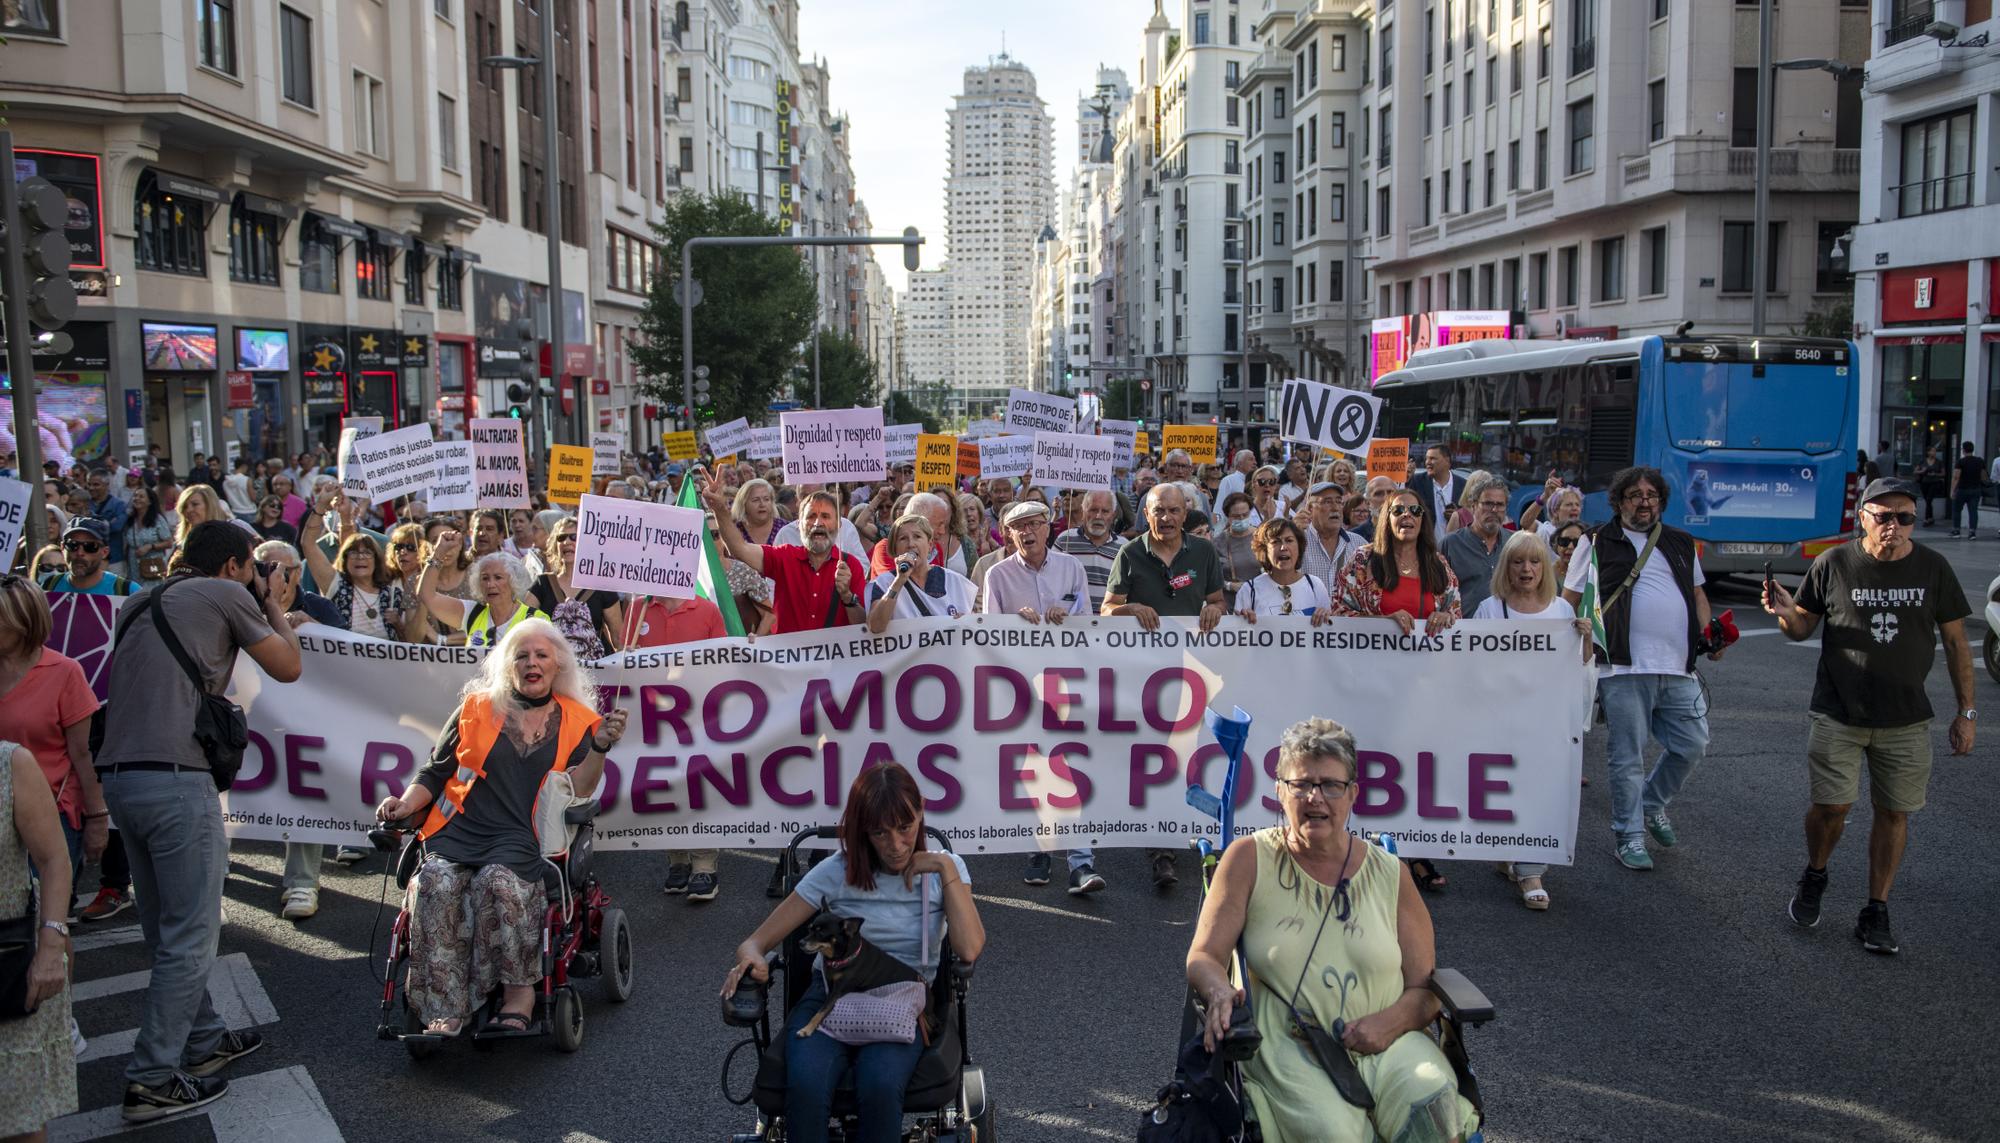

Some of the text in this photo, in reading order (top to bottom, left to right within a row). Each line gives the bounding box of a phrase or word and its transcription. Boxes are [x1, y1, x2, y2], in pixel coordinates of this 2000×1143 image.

[1750, 340, 1760, 360] 1
[1795, 350, 1821, 360] 5640
[1011, 399, 1070, 421] ¡OTRO TIPO DE
[1011, 414, 1067, 433] RESIDENCIAS!
[473, 429, 518, 443] MALTRATAR
[785, 423, 832, 450] Dignidad
[835, 429, 841, 448] y
[845, 425, 881, 448] respeto
[1166, 435, 1215, 446] ¡OTRO TIPO DE
[1678, 439, 1722, 447] CITARO
[361, 450, 388, 464] Ratios
[389, 444, 405, 456] más
[407, 438, 433, 455] justas
[435, 447, 468, 460] su robar,
[925, 443, 951, 458] ¡MAYOR
[981, 444, 1008, 459] Dignidad
[1010, 446, 1014, 458] y
[1037, 440, 1111, 466] Dignidad y respeto
[366, 453, 435, 480] en servicios sociales
[445, 464, 470, 476] llaman
[476, 456, 521, 473] AL MAYOR,
[787, 453, 884, 474] en las residencias.
[921, 462, 951, 475] RESPETO
[983, 465, 990, 474] en
[992, 462, 1001, 474] las
[370, 470, 435, 498] y residencias de mayores
[557, 471, 583, 482] devoran
[1035, 465, 1109, 485] en las residencias.
[479, 480, 523, 500] ¡JAMÁS!
[1742, 482, 1768, 492] Móvil
[584, 510, 700, 555] Dignidad y respeto
[578, 553, 694, 588] en las residencias.
[1851, 588, 1926, 601] CALL DUTY
[323, 639, 348, 656] DE
[624, 652, 685, 669] BESTE
[691, 642, 844, 665] ERRESIDENTZIA
[850, 633, 912, 657] EREDU
[919, 629, 955, 648] BAT
[961, 629, 1059, 647] POSIBLEA
[1062, 631, 1089, 648] DA
[1106, 630, 1557, 652] OUTRO MODELO DE RESIDENCIAS É POSÍBEL
[800, 663, 1207, 736] MODELO
[231, 729, 327, 799] DE
[999, 742, 1093, 811] ES
[223, 811, 351, 831] ación de los derechos
[597, 829, 604, 840] y
[607, 826, 663, 839] personas
[666, 825, 687, 836] con
[692, 821, 771, 837] discapacidad
[781, 822, 800, 834] NO
[979, 824, 1033, 838] laborales
[1036, 823, 1051, 836] de
[1054, 822, 1070, 835] las
[1073, 820, 1148, 836] trabajadoras
[1158, 821, 1177, 833] NO
[1181, 825, 1187, 833] a
[1191, 821, 1201, 834] la
[1205, 823, 1256, 836] obena
[1440, 830, 1457, 844] de
[1460, 831, 1472, 844] la
[1475, 832, 1559, 849] dependencia
